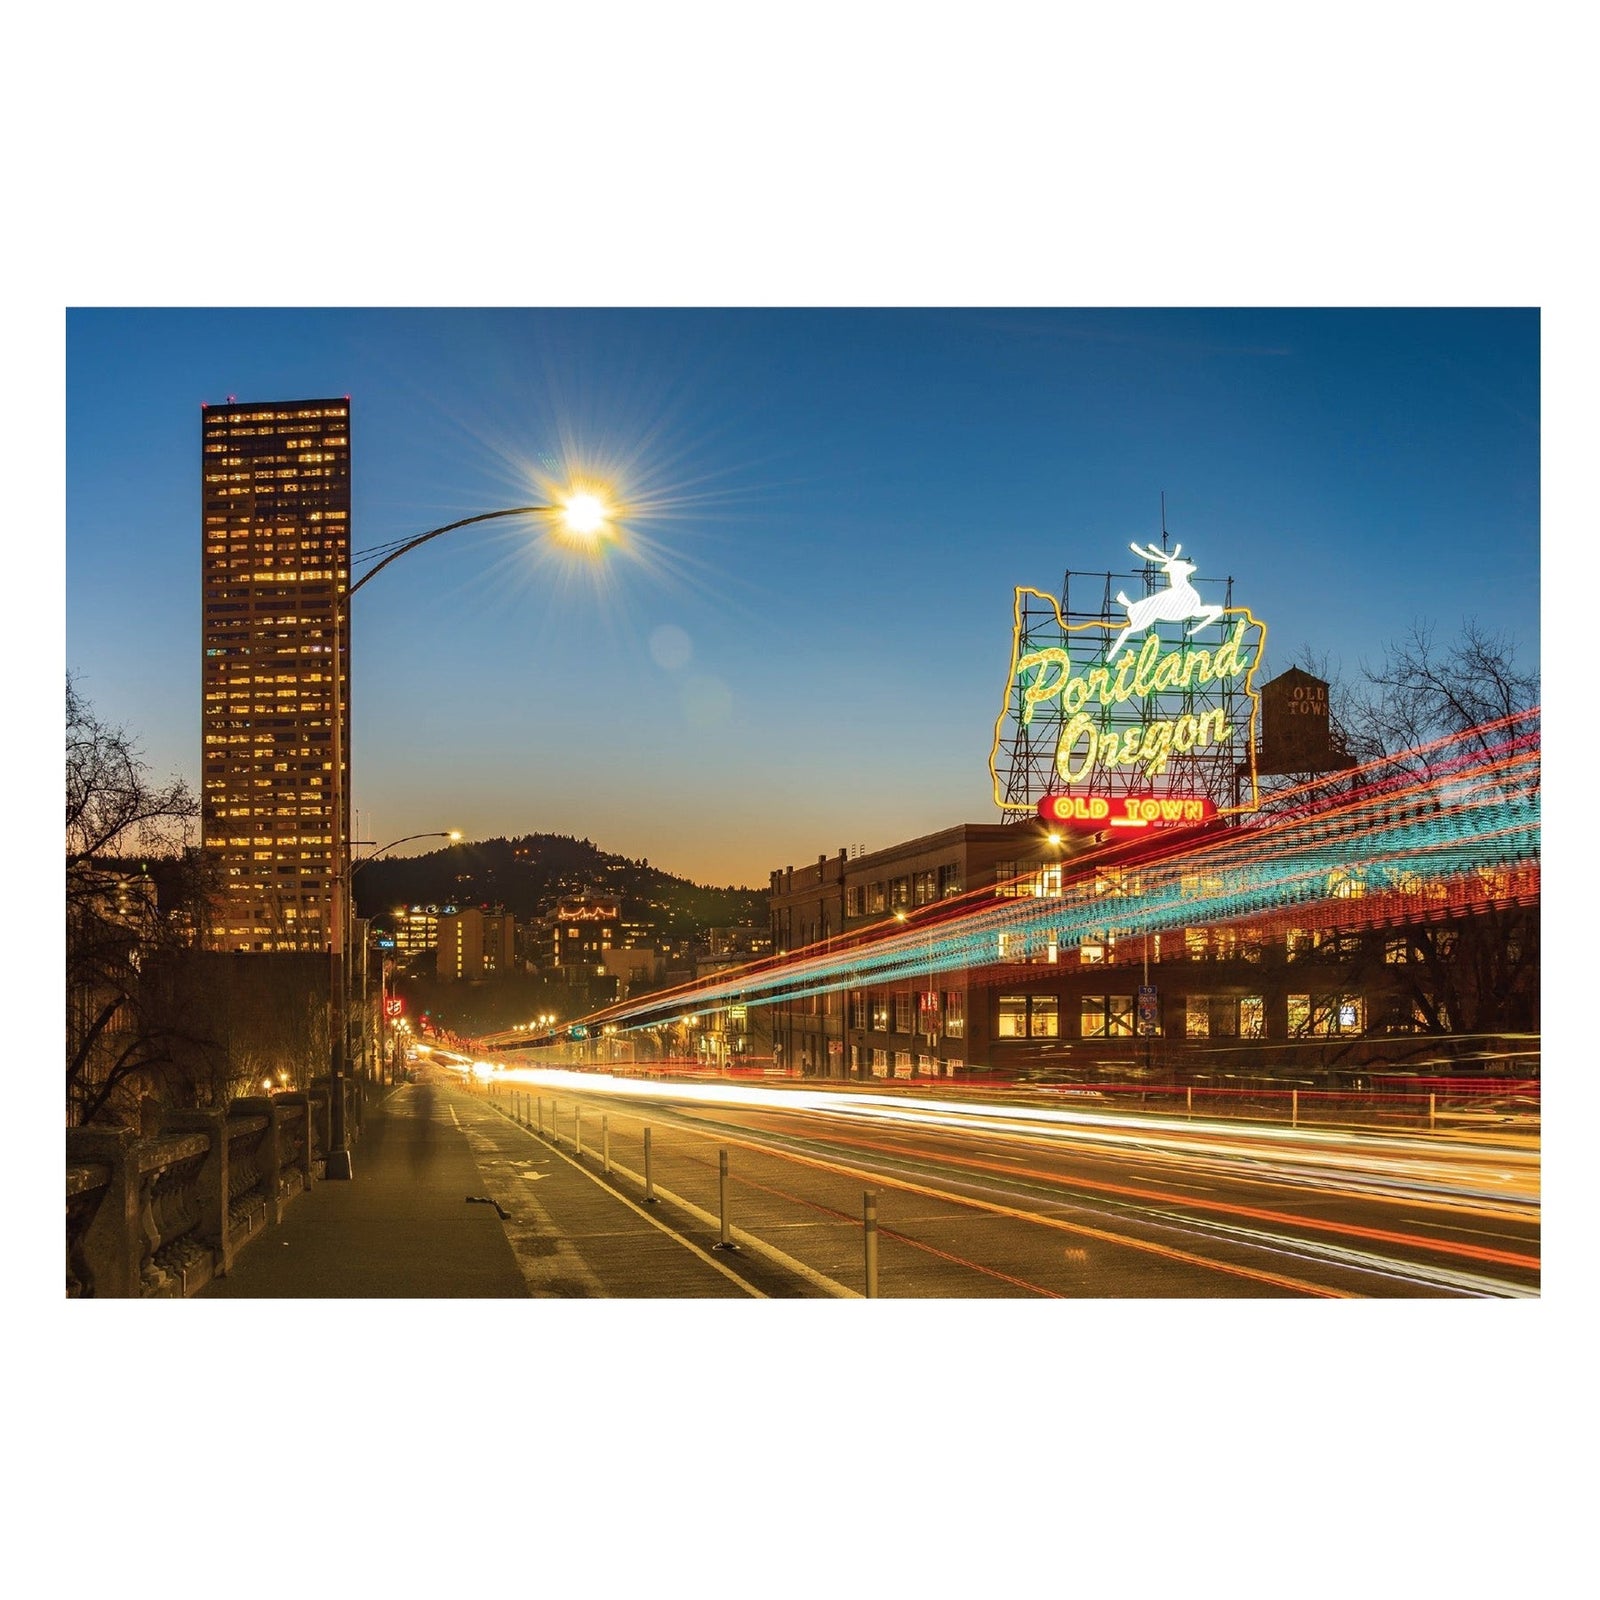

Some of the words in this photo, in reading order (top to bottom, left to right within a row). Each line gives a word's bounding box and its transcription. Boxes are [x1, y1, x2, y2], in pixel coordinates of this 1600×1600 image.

[1017, 618, 1248, 724] Portland
[1293, 686, 1325, 701] OLD
[1056, 707, 1233, 783] Oregon
[1053, 797, 1109, 819] OLD
[1124, 799, 1204, 821] TOWN
[1144, 1010, 1152, 1020] 5
